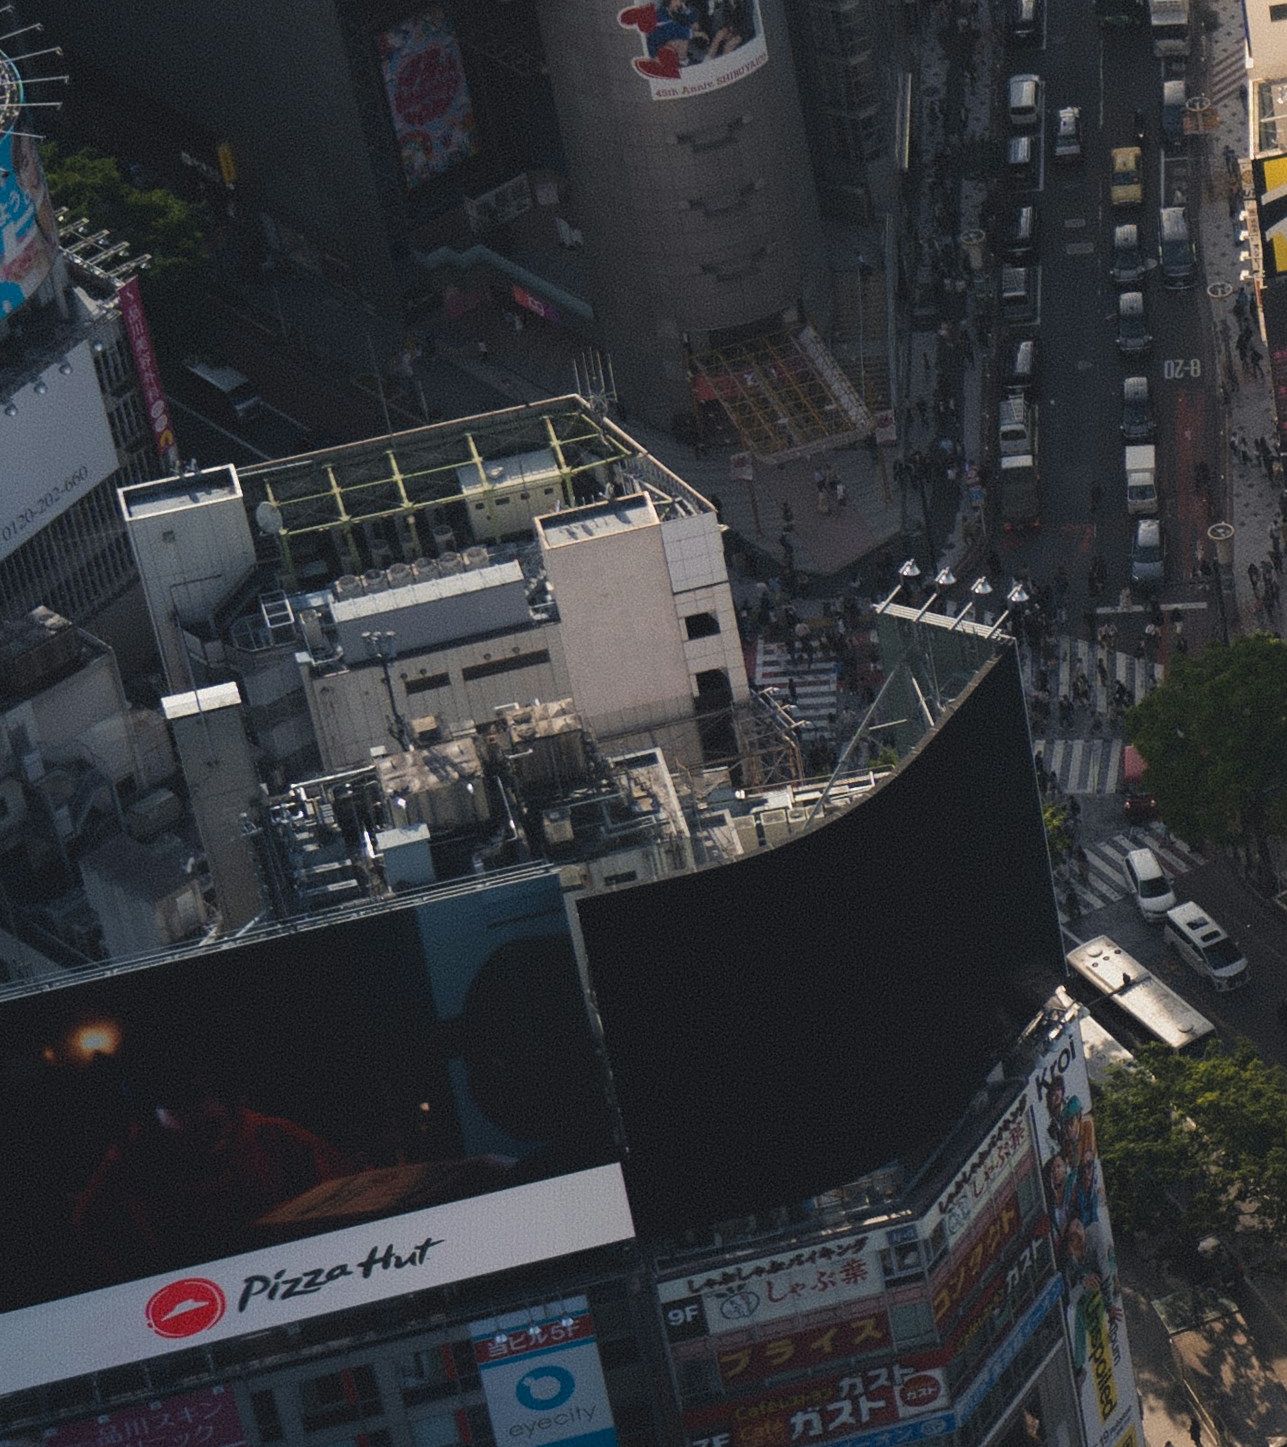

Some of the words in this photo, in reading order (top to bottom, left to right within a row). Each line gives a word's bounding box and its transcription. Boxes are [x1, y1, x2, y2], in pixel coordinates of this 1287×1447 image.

[1034, 1036, 1078, 1104] Kroi
[238, 1254, 350, 1312] Pizza
[347, 1237, 447, 1279] Hut
[667, 1304, 700, 1327] 9F
[839, 1362, 917, 1399] ガスト
[509, 1404, 597, 1440] eyecity
[790, 1398, 887, 1441] ガスト
